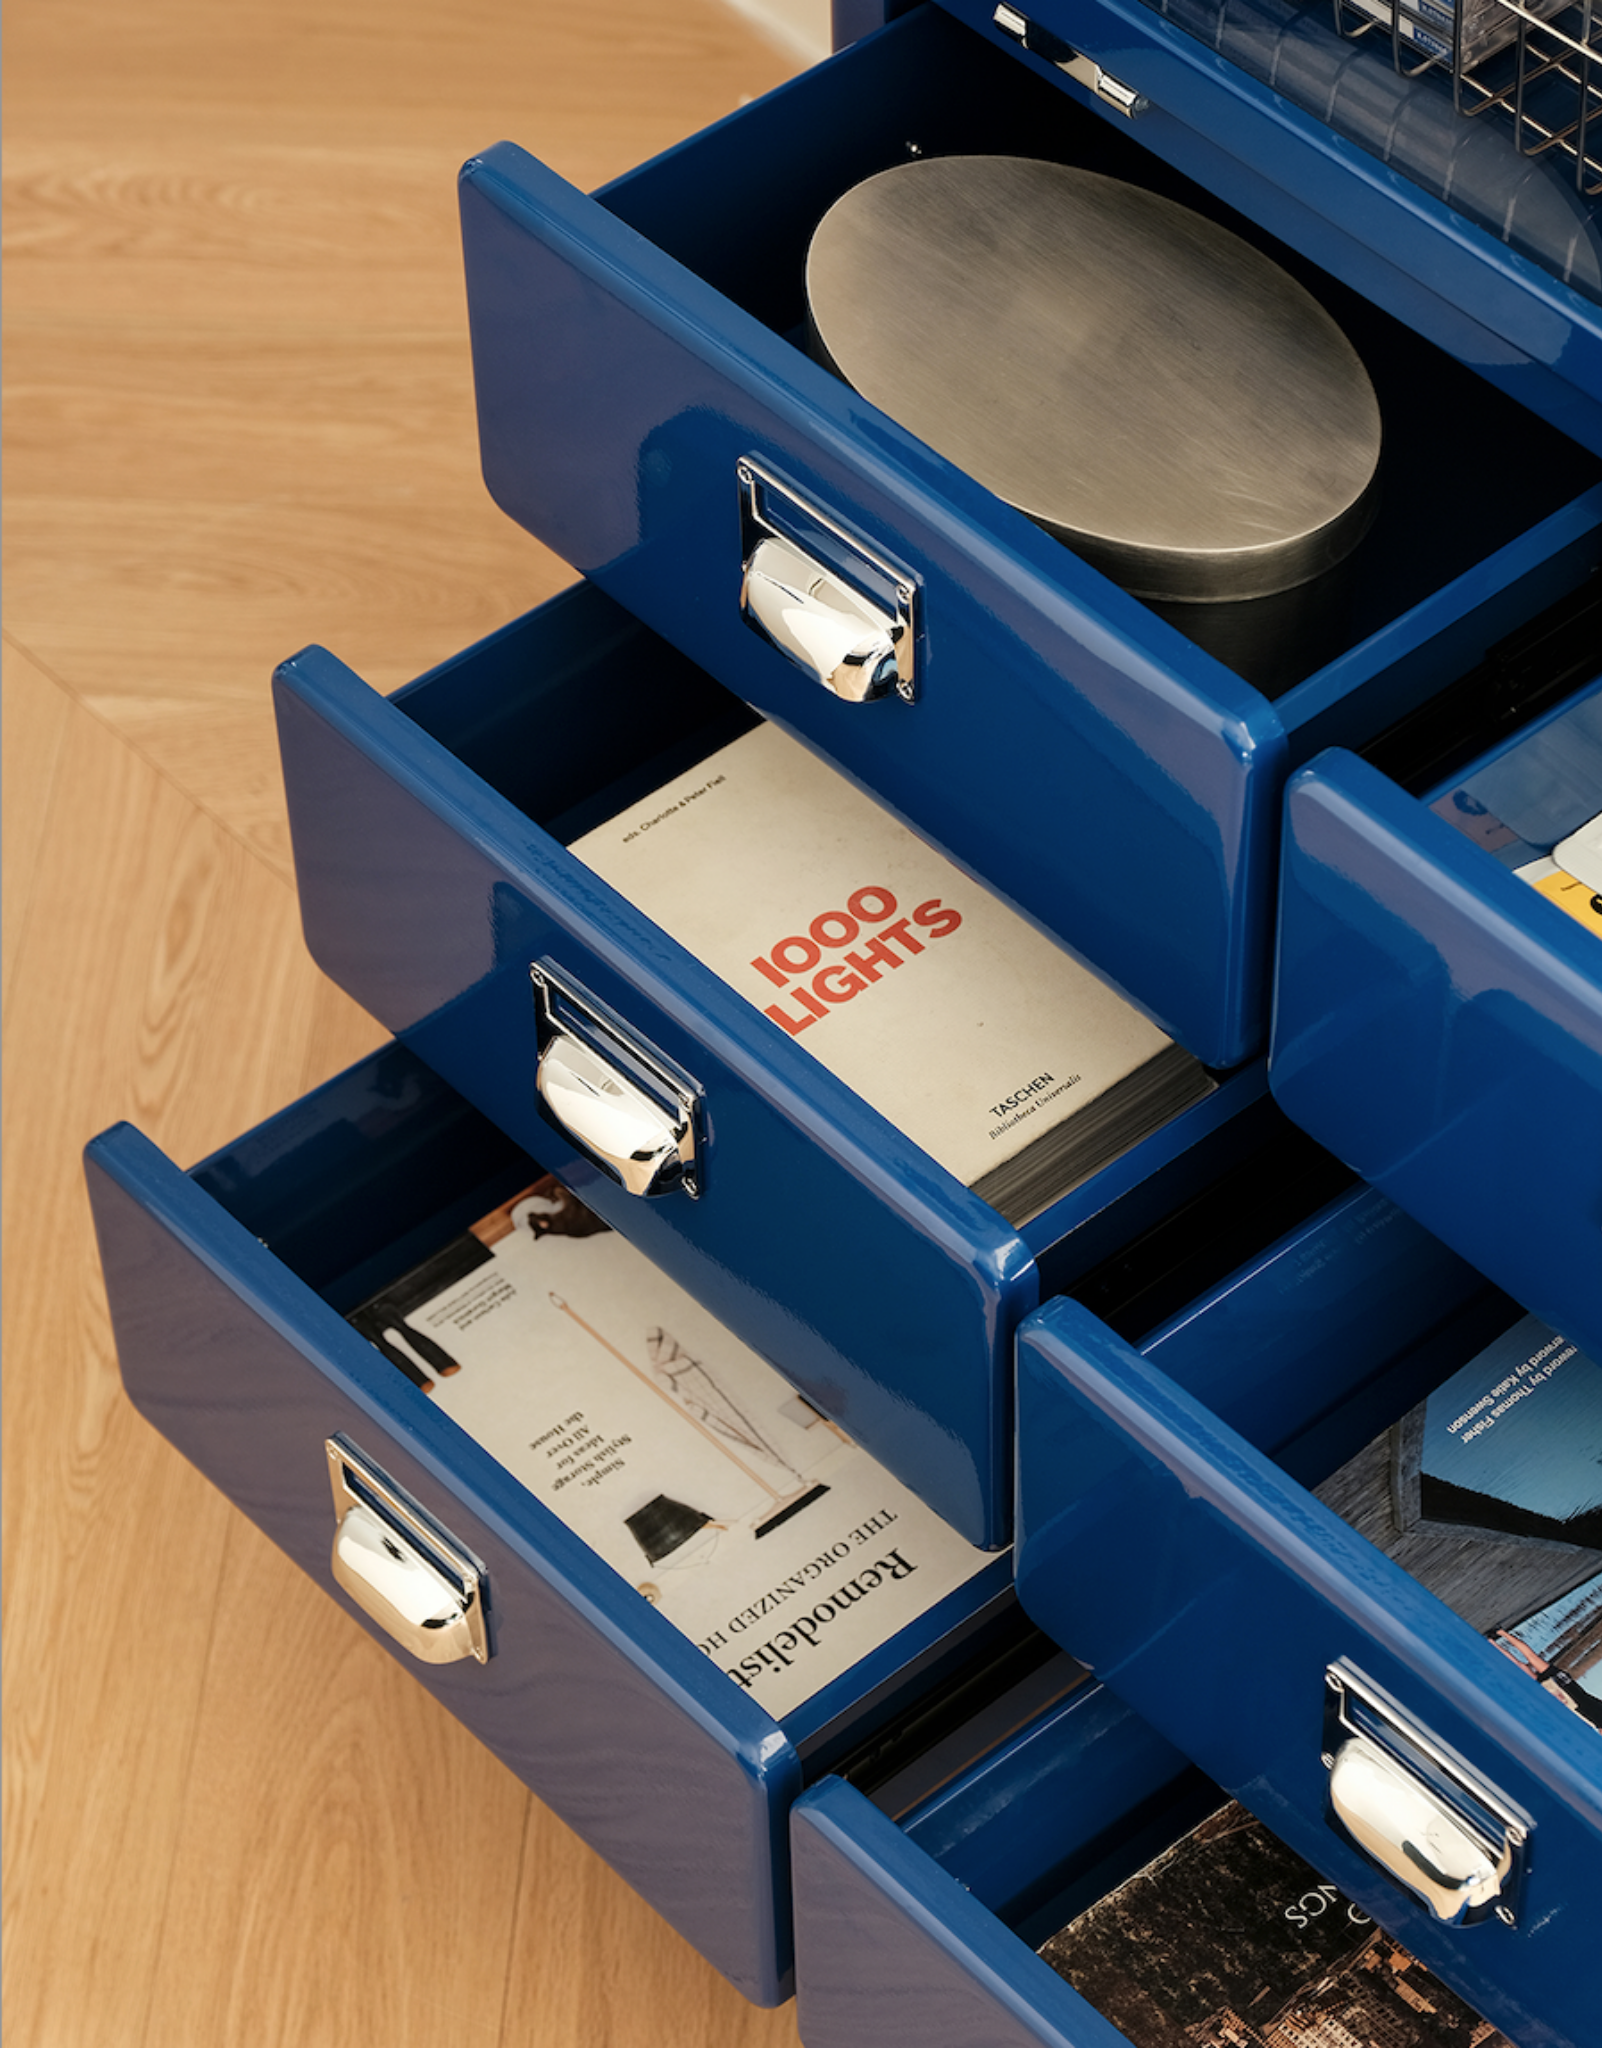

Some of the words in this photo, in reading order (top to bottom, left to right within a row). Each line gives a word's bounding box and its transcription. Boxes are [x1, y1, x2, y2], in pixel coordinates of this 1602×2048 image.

[640, 806, 678, 831] Charlotte
[684, 786, 706, 803] Peter
[764, 899, 963, 1037] LIGHTS
[988, 1106, 1036, 1140] Bibliotheca
[1035, 1074, 1082, 1107] Universalis
[989, 1072, 1055, 1117] TASCHEN
[1515, 1362, 1534, 1378] by
[1529, 1372, 1547, 1386] by
[1490, 1374, 1520, 1397] Katie
[1446, 1395, 1495, 1434] Swenson
[1491, 1385, 1534, 1417] Thomas
[565, 1411, 584, 1426] the
[1461, 1415, 1495, 1443] Fisher
[529, 1424, 565, 1451] House
[572, 1425, 590, 1441] All
[573, 1434, 605, 1456] Ideas
[546, 1438, 574, 1458] Over
[593, 1434, 632, 1462] Stylish
[552, 1459, 596, 1491] Storage
[556, 1455, 575, 1470] for
[581, 1458, 625, 1486] Simple,
[848, 1508, 898, 1545] THE
[728, 1542, 851, 1633] ORGANIZED
[727, 1547, 918, 1688] Remodelist
